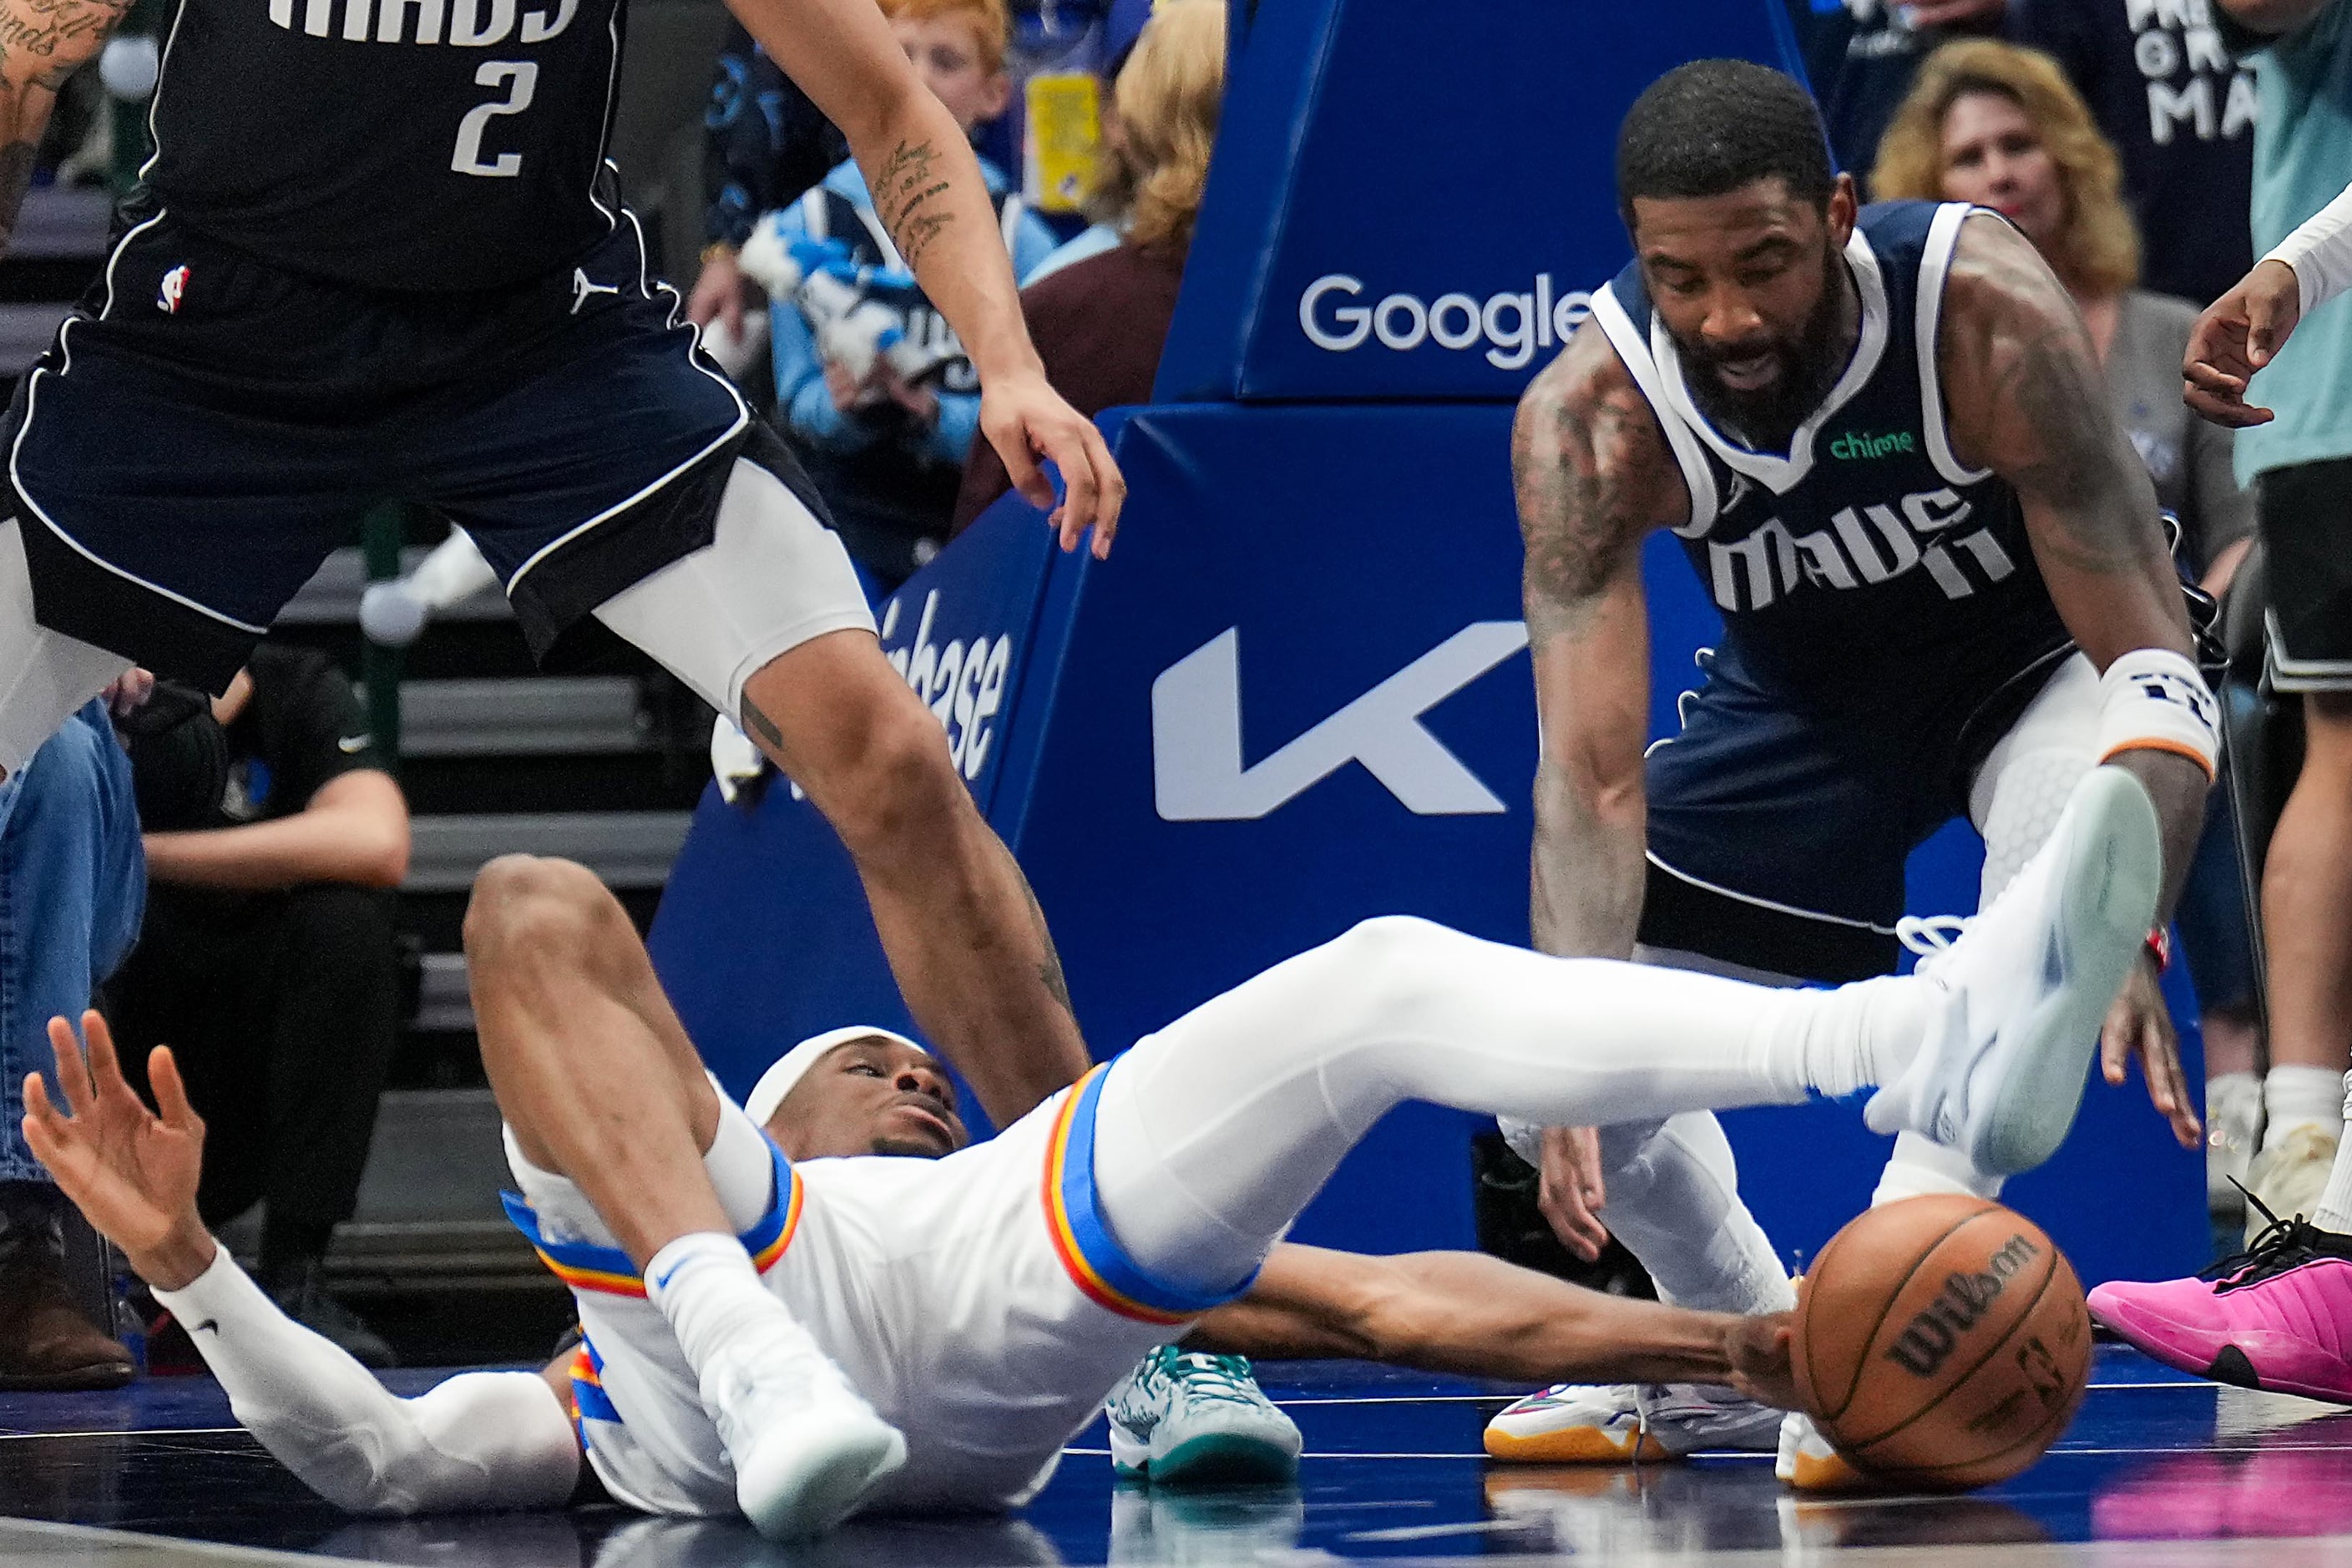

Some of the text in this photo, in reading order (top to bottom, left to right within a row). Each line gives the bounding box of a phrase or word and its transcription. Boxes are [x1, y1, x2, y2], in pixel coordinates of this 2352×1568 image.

[451, 59, 539, 177] 2
[1299, 272, 1591, 371] Google
[1830, 430, 1915, 460] chime
[1920, 526, 2016, 600] 11
[1884, 1232, 2041, 1378] Wilson
